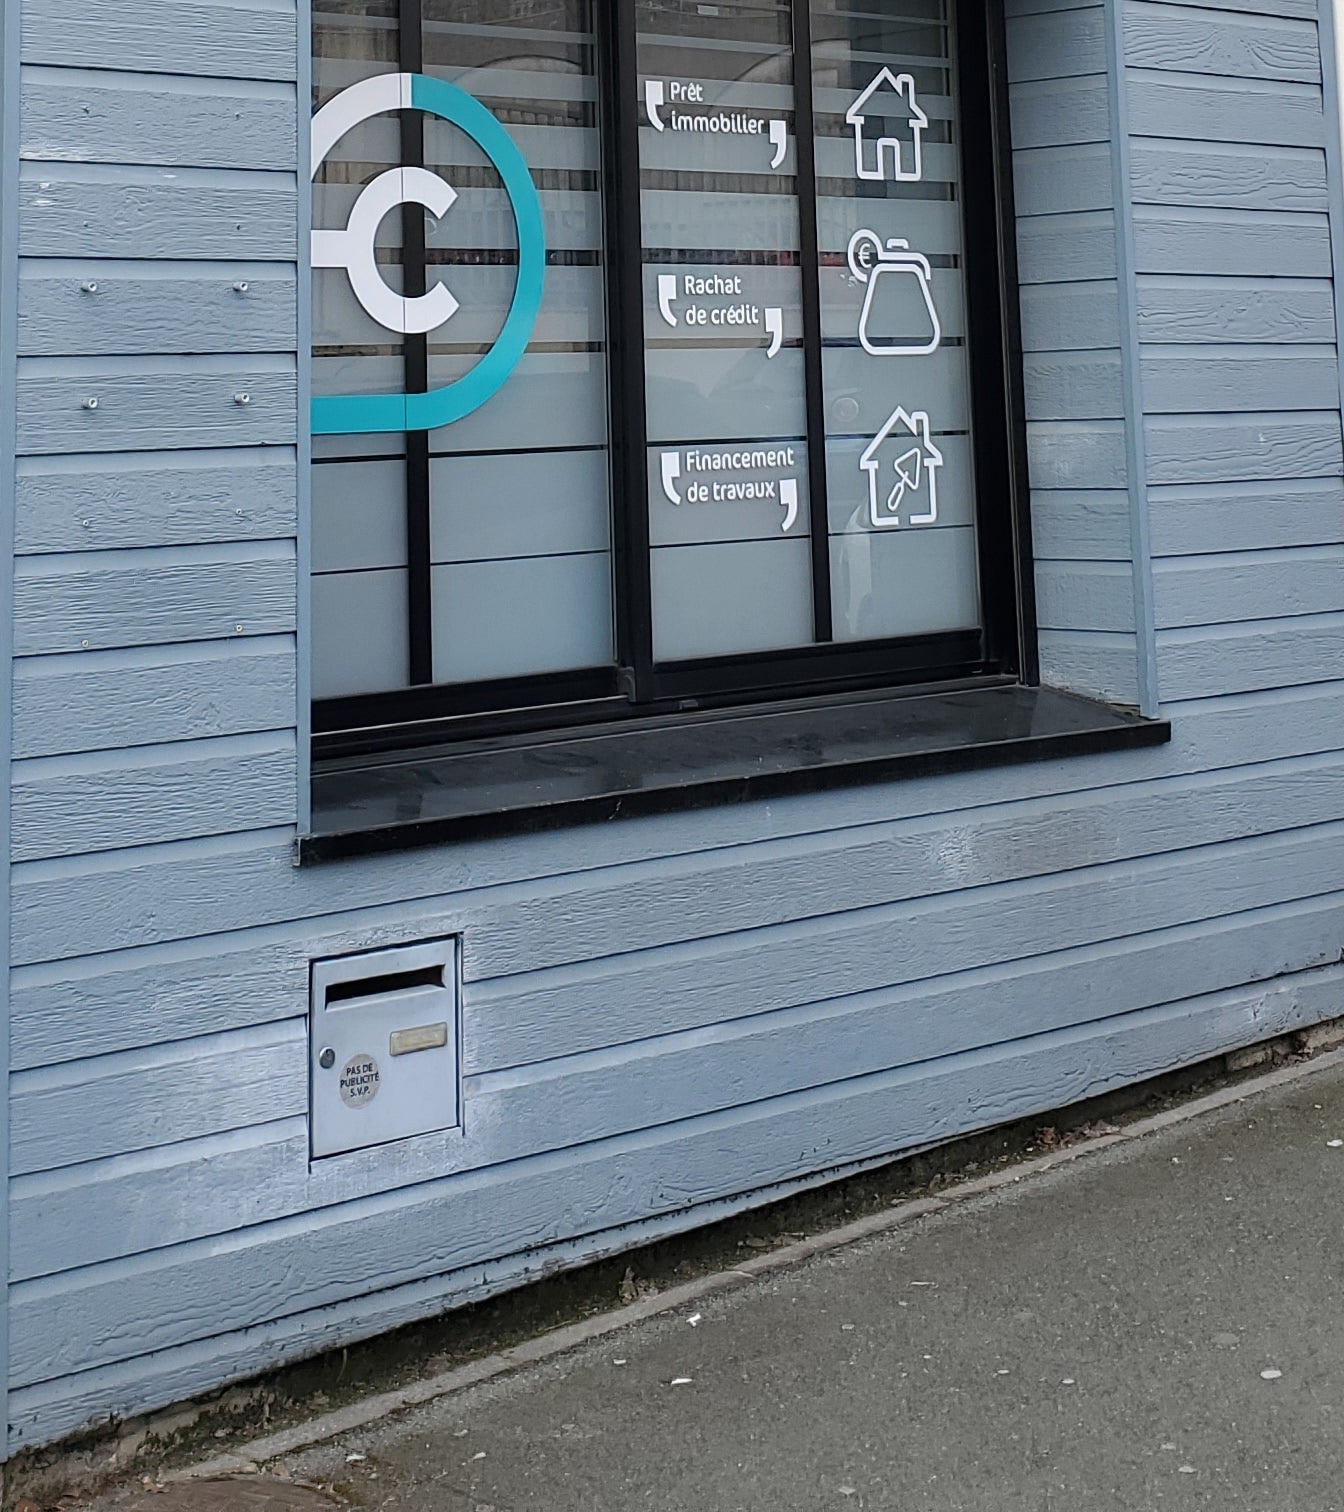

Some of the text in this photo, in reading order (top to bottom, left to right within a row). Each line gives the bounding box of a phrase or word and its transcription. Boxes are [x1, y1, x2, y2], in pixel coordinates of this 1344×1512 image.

[669, 81, 704, 102] Prêt
[670, 109, 765, 135] immobilier
[683, 274, 742, 296] Rachat
[685, 304, 759, 326] de crédit
[685, 445, 795, 473] Financement
[686, 479, 776, 503] de travaux
[346, 1062, 373, 1076] PAS DE
